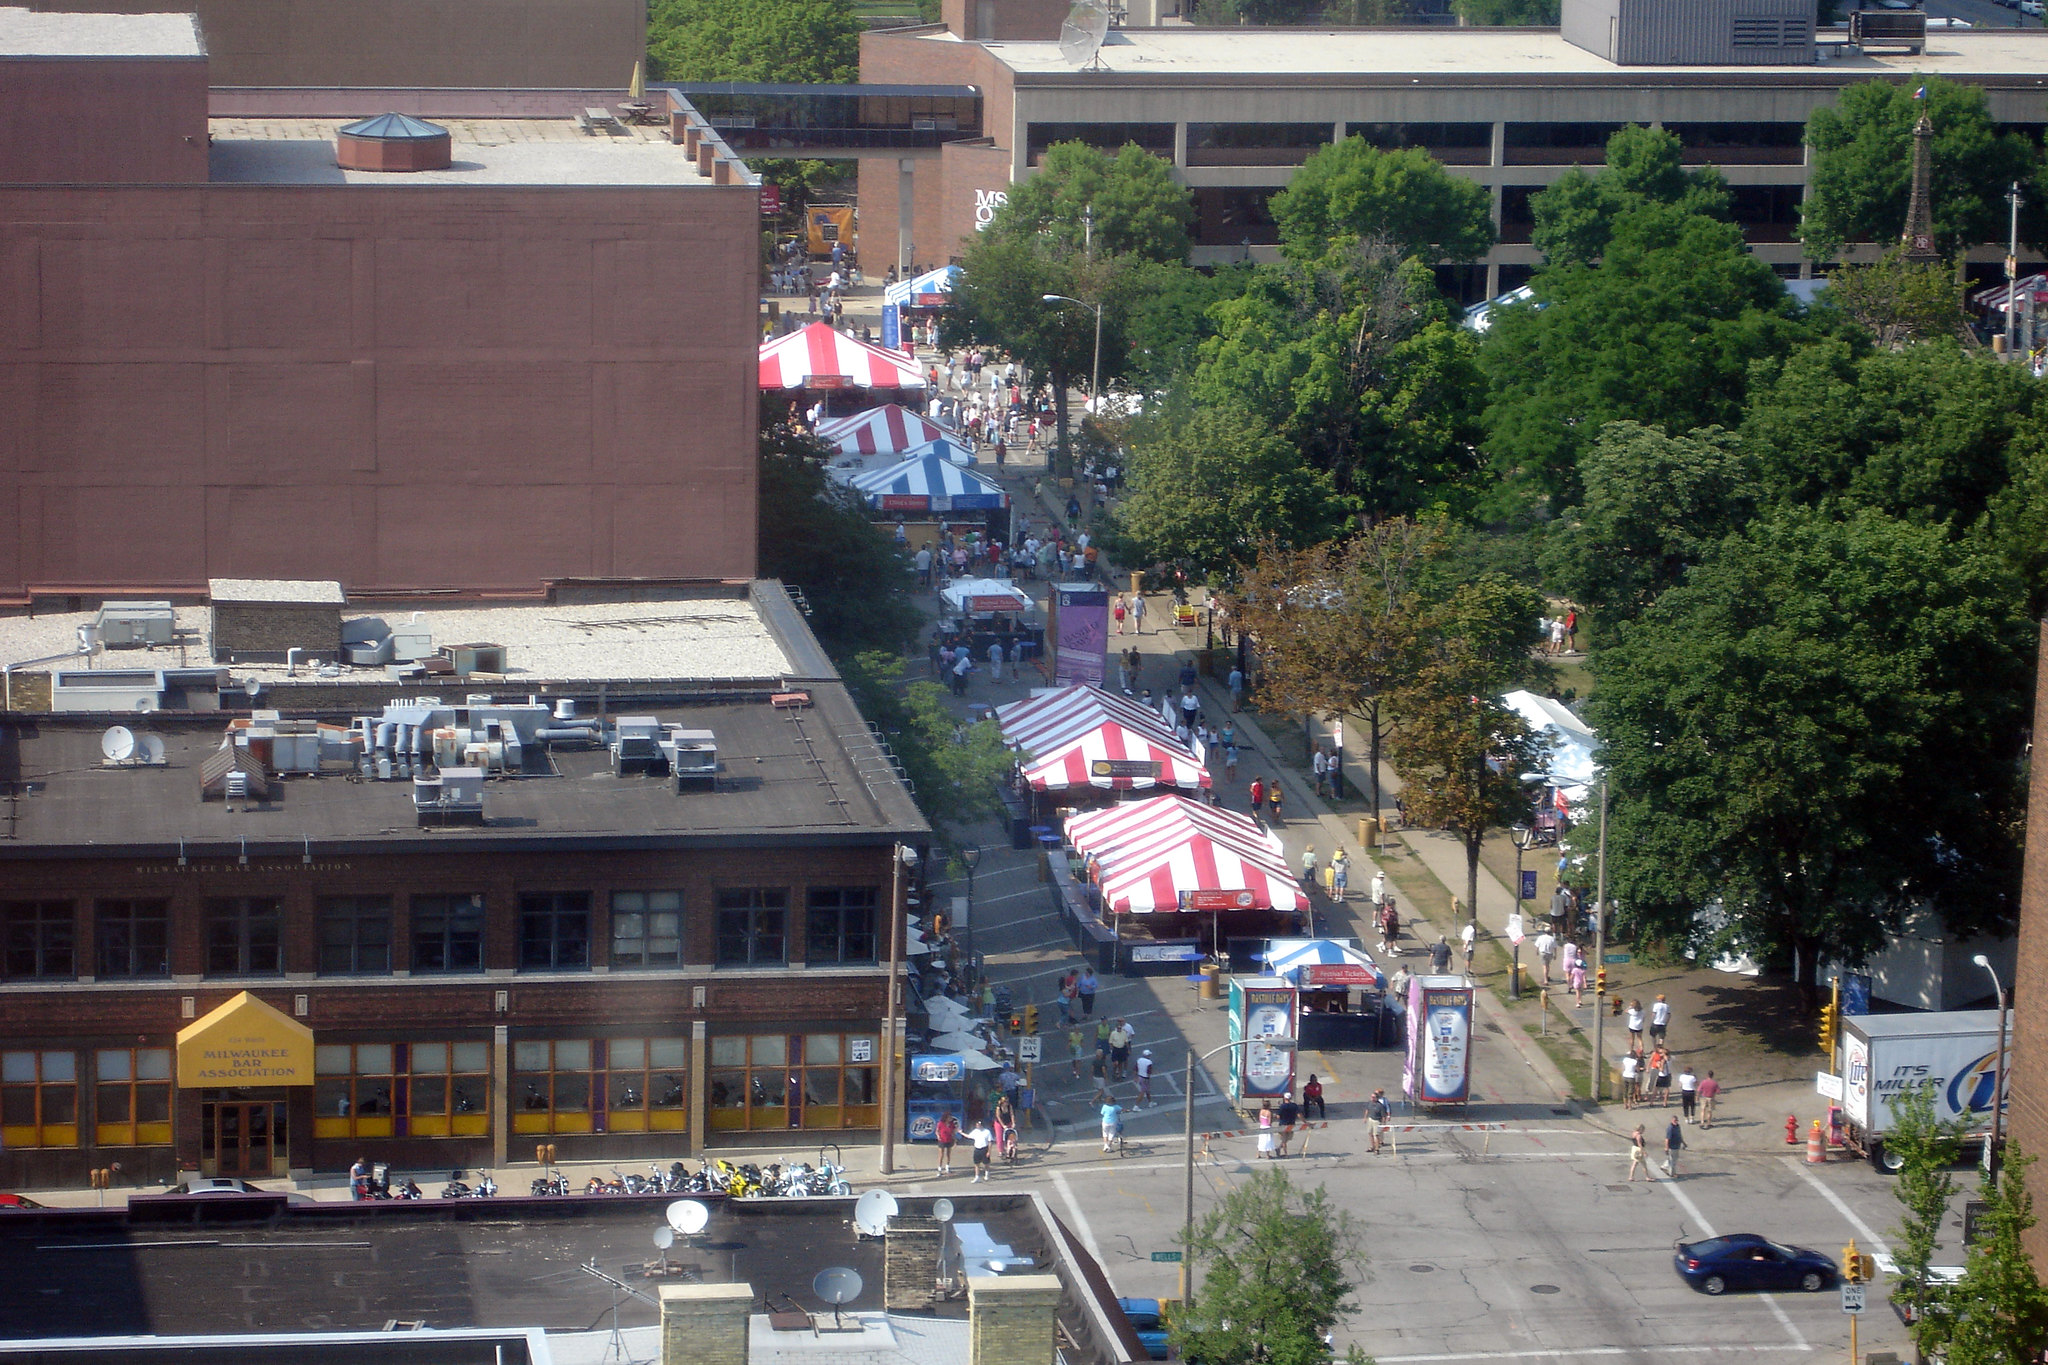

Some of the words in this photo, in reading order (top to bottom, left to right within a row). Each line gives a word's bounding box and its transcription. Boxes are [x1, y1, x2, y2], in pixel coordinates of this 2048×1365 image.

[975, 189, 1008, 207] MS
[258, 863, 352, 872] ASSOCIATION
[203, 1049, 289, 1059] MILWAUKEE
[233, 1059, 262, 1067] BAR
[198, 1067, 296, 1078] ASSOCIATION
[1893, 1064, 1930, 1076] IT'S
[1874, 1077, 1945, 1090] MILLER
[1845, 1286, 1862, 1295] ONE
[1844, 1294, 1861, 1302] WAY
